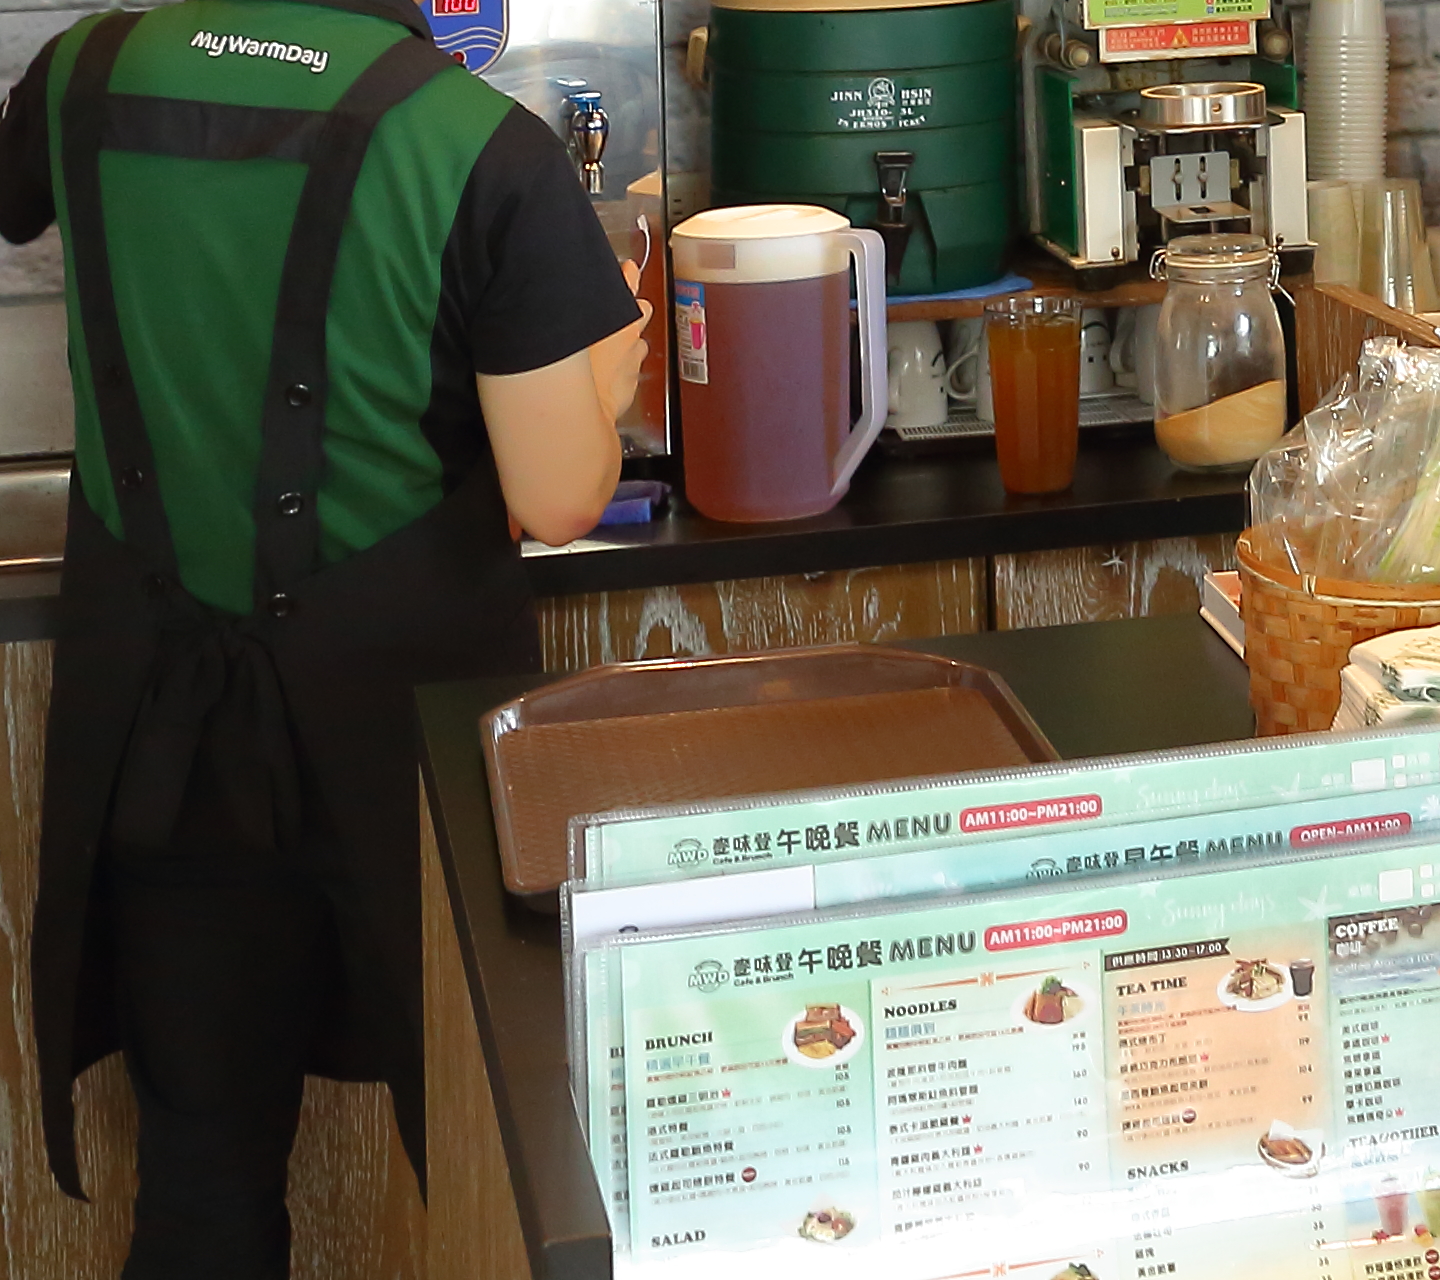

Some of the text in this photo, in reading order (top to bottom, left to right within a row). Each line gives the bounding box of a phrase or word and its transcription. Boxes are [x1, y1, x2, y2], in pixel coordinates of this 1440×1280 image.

[191, 29, 329, 74] MyWarmDay
[776, 821, 860, 856] 午晚餐
[866, 812, 952, 843] MENU
[964, 798, 1099, 829] AM11:00~PM21:00
[1335, 916, 1400, 939] COFFEE
[798, 941, 883, 974] 午晚餐
[889, 930, 977, 962] MENU
[989, 914, 1125, 947] AM11:00~PM21:00
[1116, 976, 1188, 997] TEA TIME
[884, 998, 958, 1020] NOODLES
[645, 1032, 713, 1051] BRUNCH
[1127, 1160, 1190, 1180] SNACKS
[651, 1228, 707, 1249] SALAD
